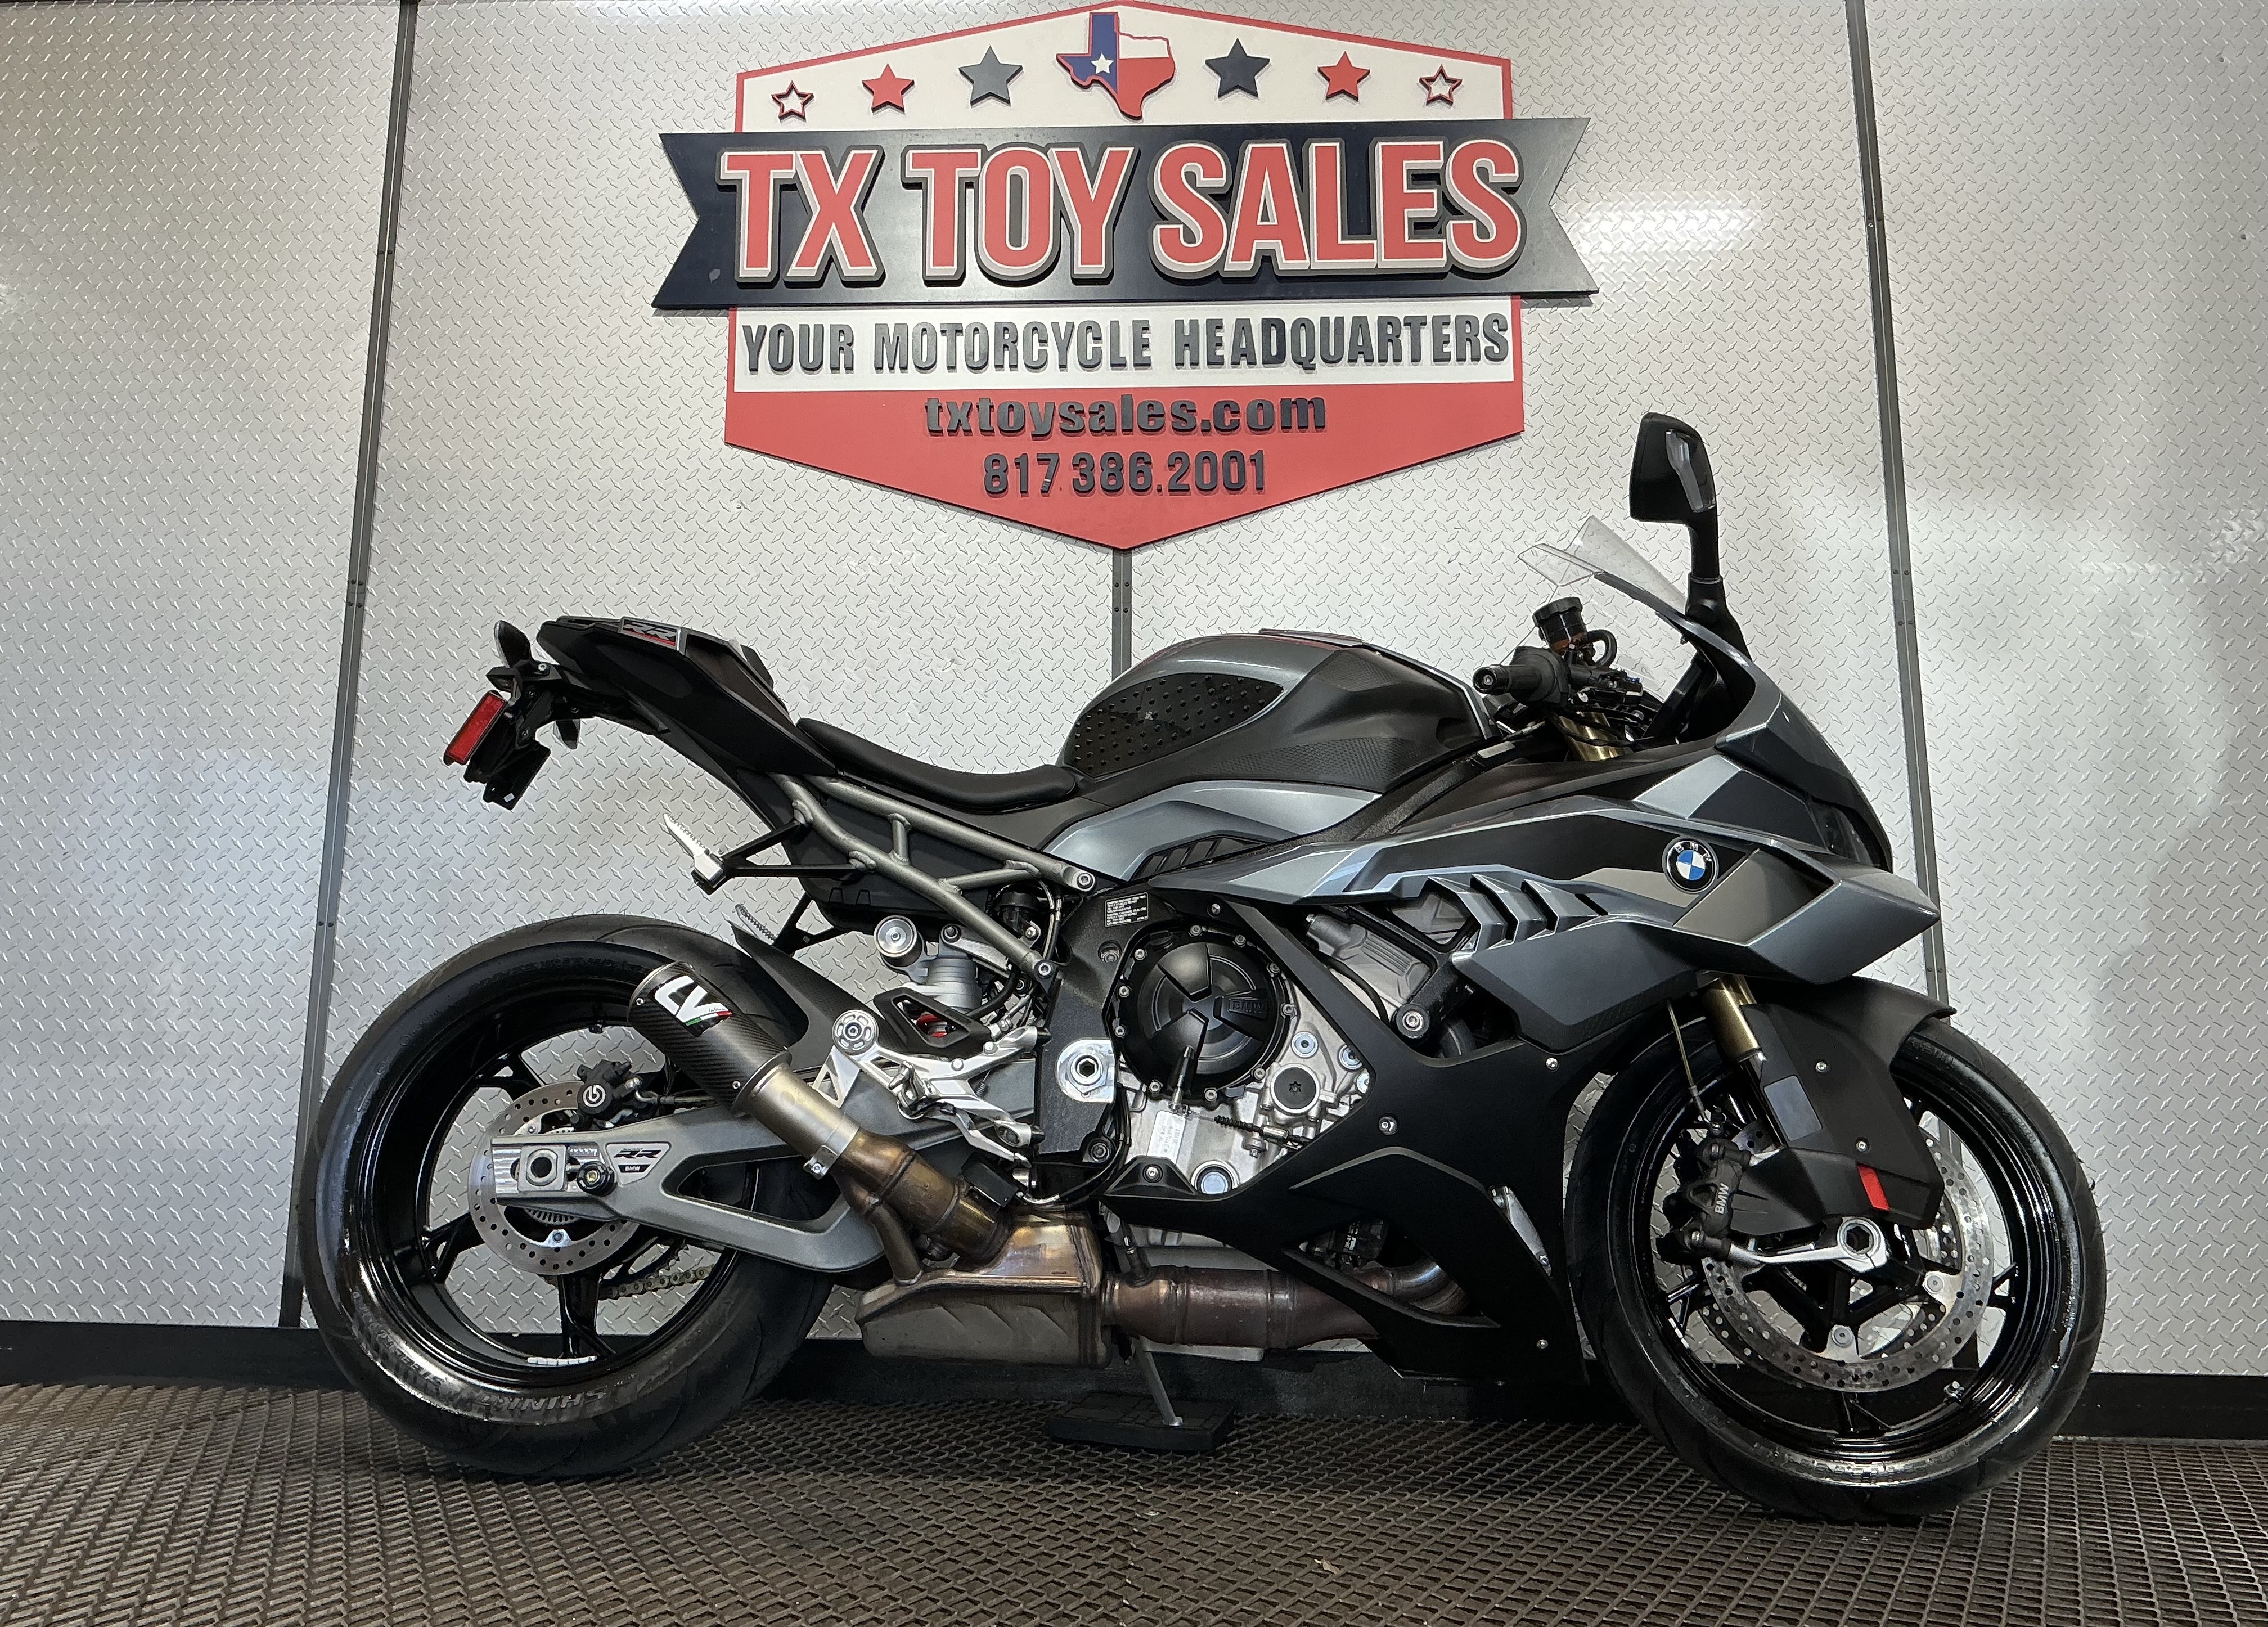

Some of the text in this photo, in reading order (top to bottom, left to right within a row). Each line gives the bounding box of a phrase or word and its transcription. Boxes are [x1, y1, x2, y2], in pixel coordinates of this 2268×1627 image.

[719, 138, 1520, 278] TX TOY SALES
[742, 313, 1510, 372] YOUR MOTORCYCLE HEADQUARTERS
[924, 394, 1326, 441] txtoysales.com
[623, 622, 677, 641] RR
[1673, 840, 1712, 862] BMW
[613, 1149, 663, 1159] RR
[1714, 1182, 1729, 1215] BMW
